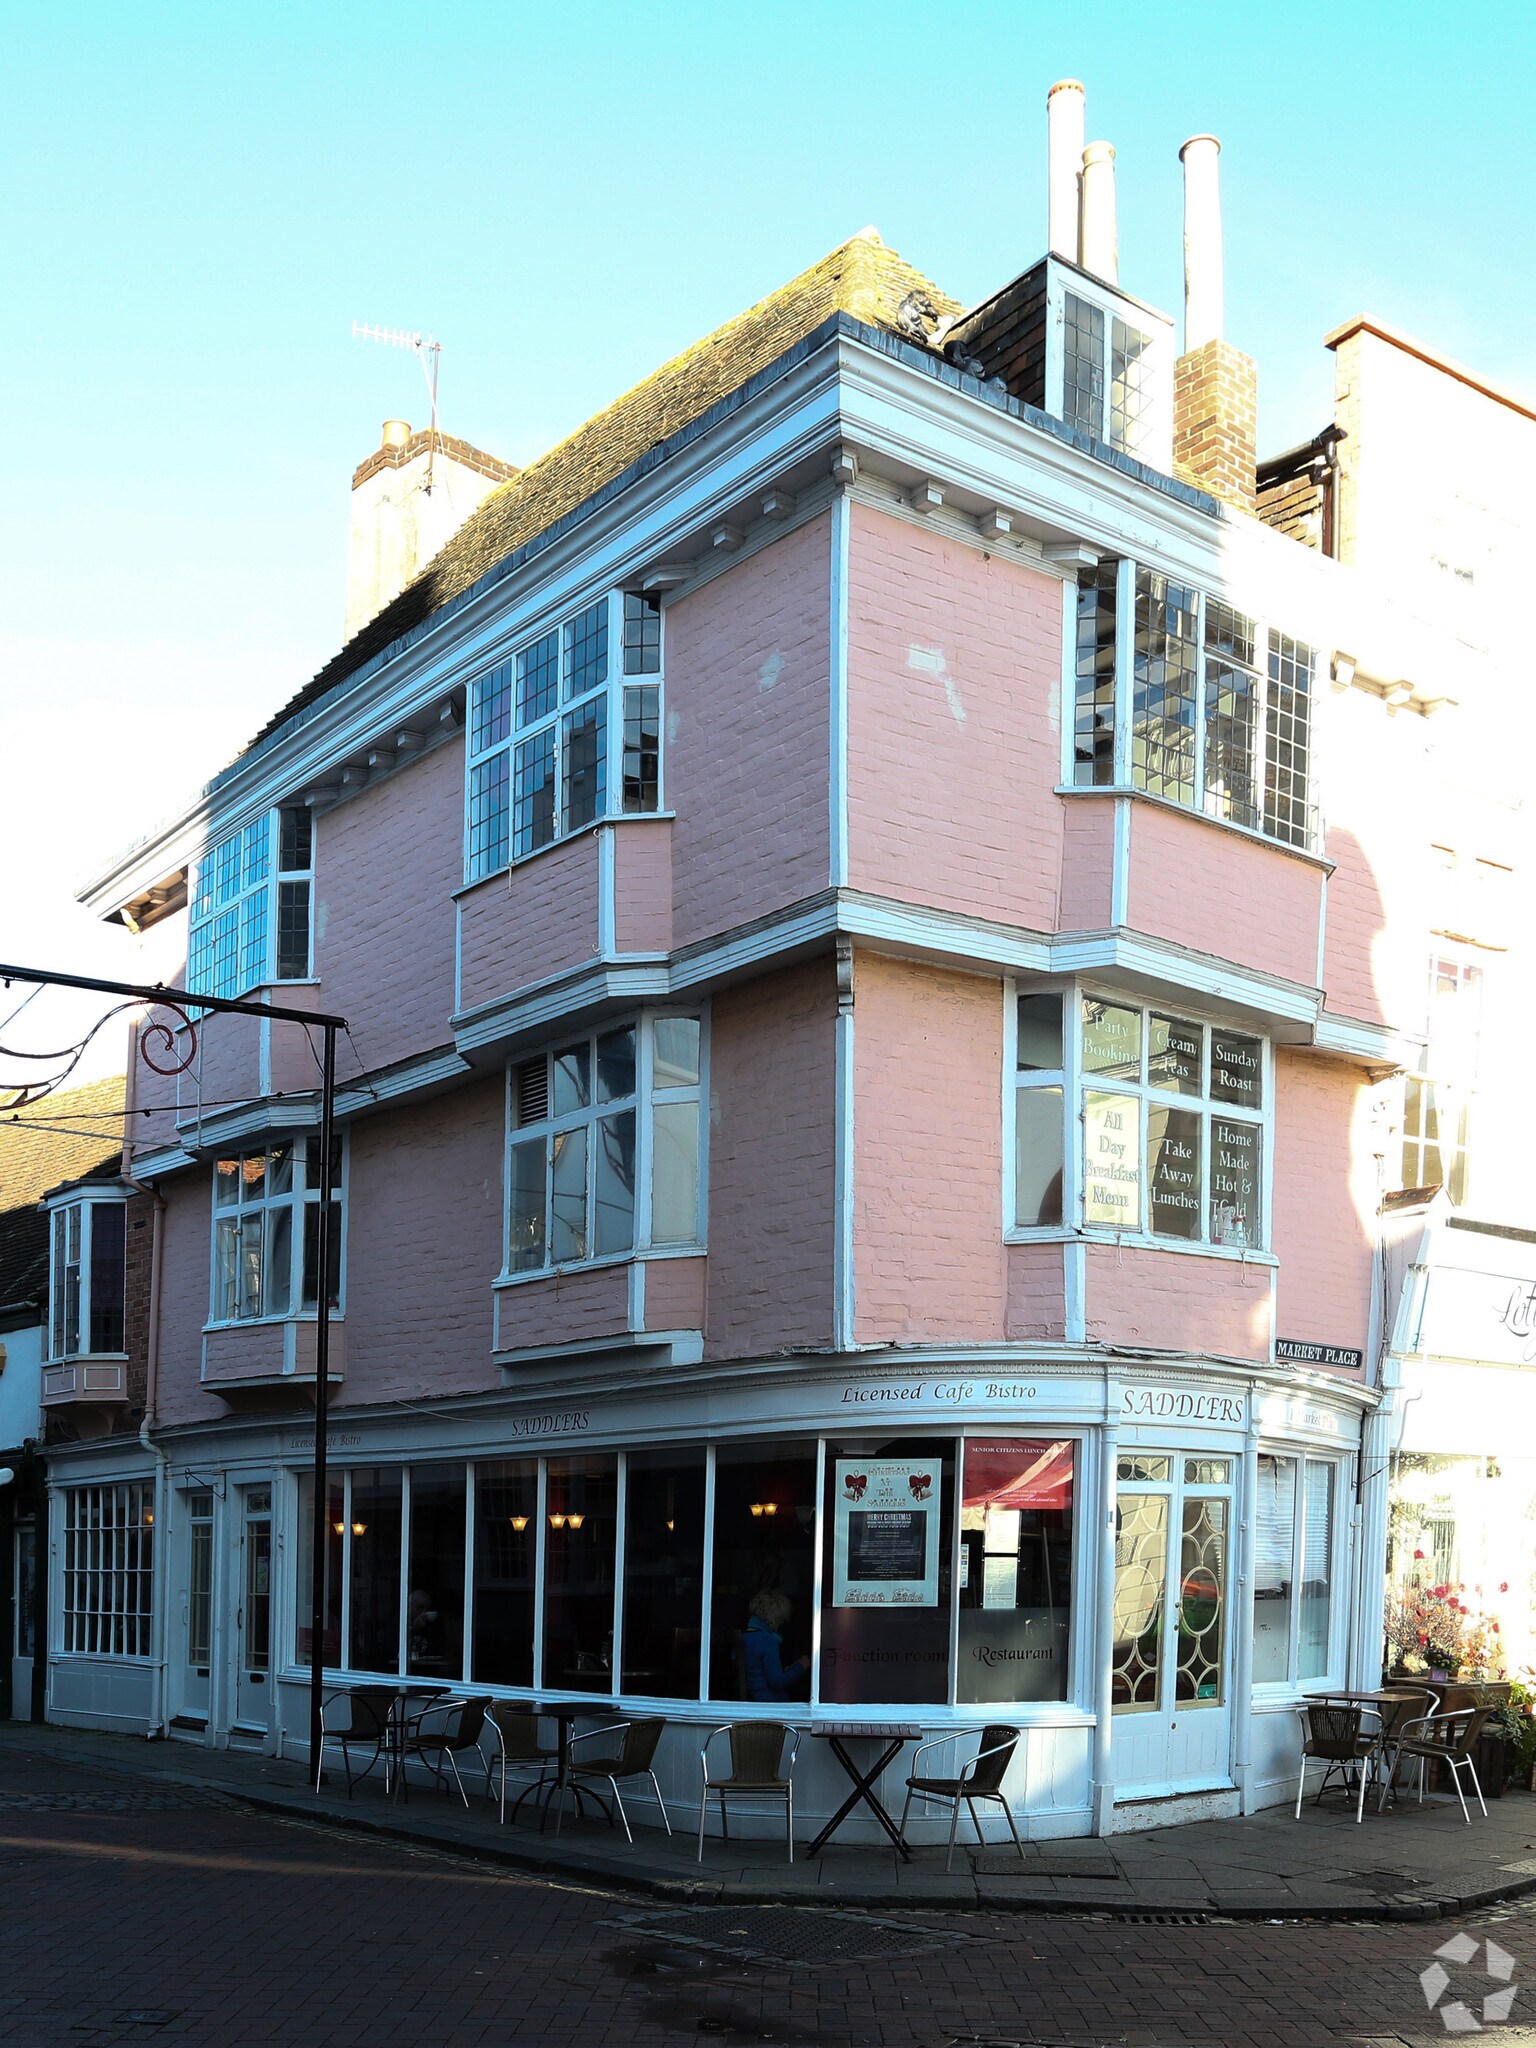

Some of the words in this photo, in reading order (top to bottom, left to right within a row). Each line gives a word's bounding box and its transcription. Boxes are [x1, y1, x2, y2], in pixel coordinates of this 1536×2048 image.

[1095, 1014, 1128, 1040] Party
[1160, 1056, 1189, 1077] Teas
[1216, 1044, 1258, 1072] Sunday
[1220, 1069, 1253, 1092] Roast
[1103, 1110, 1123, 1130] All
[1099, 1135, 1126, 1160] Day
[1218, 1125, 1252, 1147] Home
[1163, 1138, 1193, 1159] Take
[1086, 1159, 1140, 1184] Breakfast
[1219, 1150, 1250, 1171] Made
[1160, 1163, 1194, 1187] Away
[1216, 1174, 1239, 1193] Hot
[1241, 1178, 1253, 1195] &
[1152, 1186, 1200, 1210] Lunches
[1277, 1341, 1323, 1361] MARKET
[1324, 1348, 1359, 1367] PLACE
[840, 1381, 927, 1403] Licensed
[933, 1381, 974, 1404] Café
[985, 1383, 1037, 1399] Bistro
[1121, 1389, 1244, 1423] SADDLERS
[511, 1410, 590, 1437] SADDLERS
[340, 1433, 362, 1447] Bistro
[866, 1513, 883, 1521] MERRY
[884, 1513, 912, 1521] CHRISTMAS
[905, 1651, 946, 1663] room
[973, 1646, 1054, 1668] Restaurant
